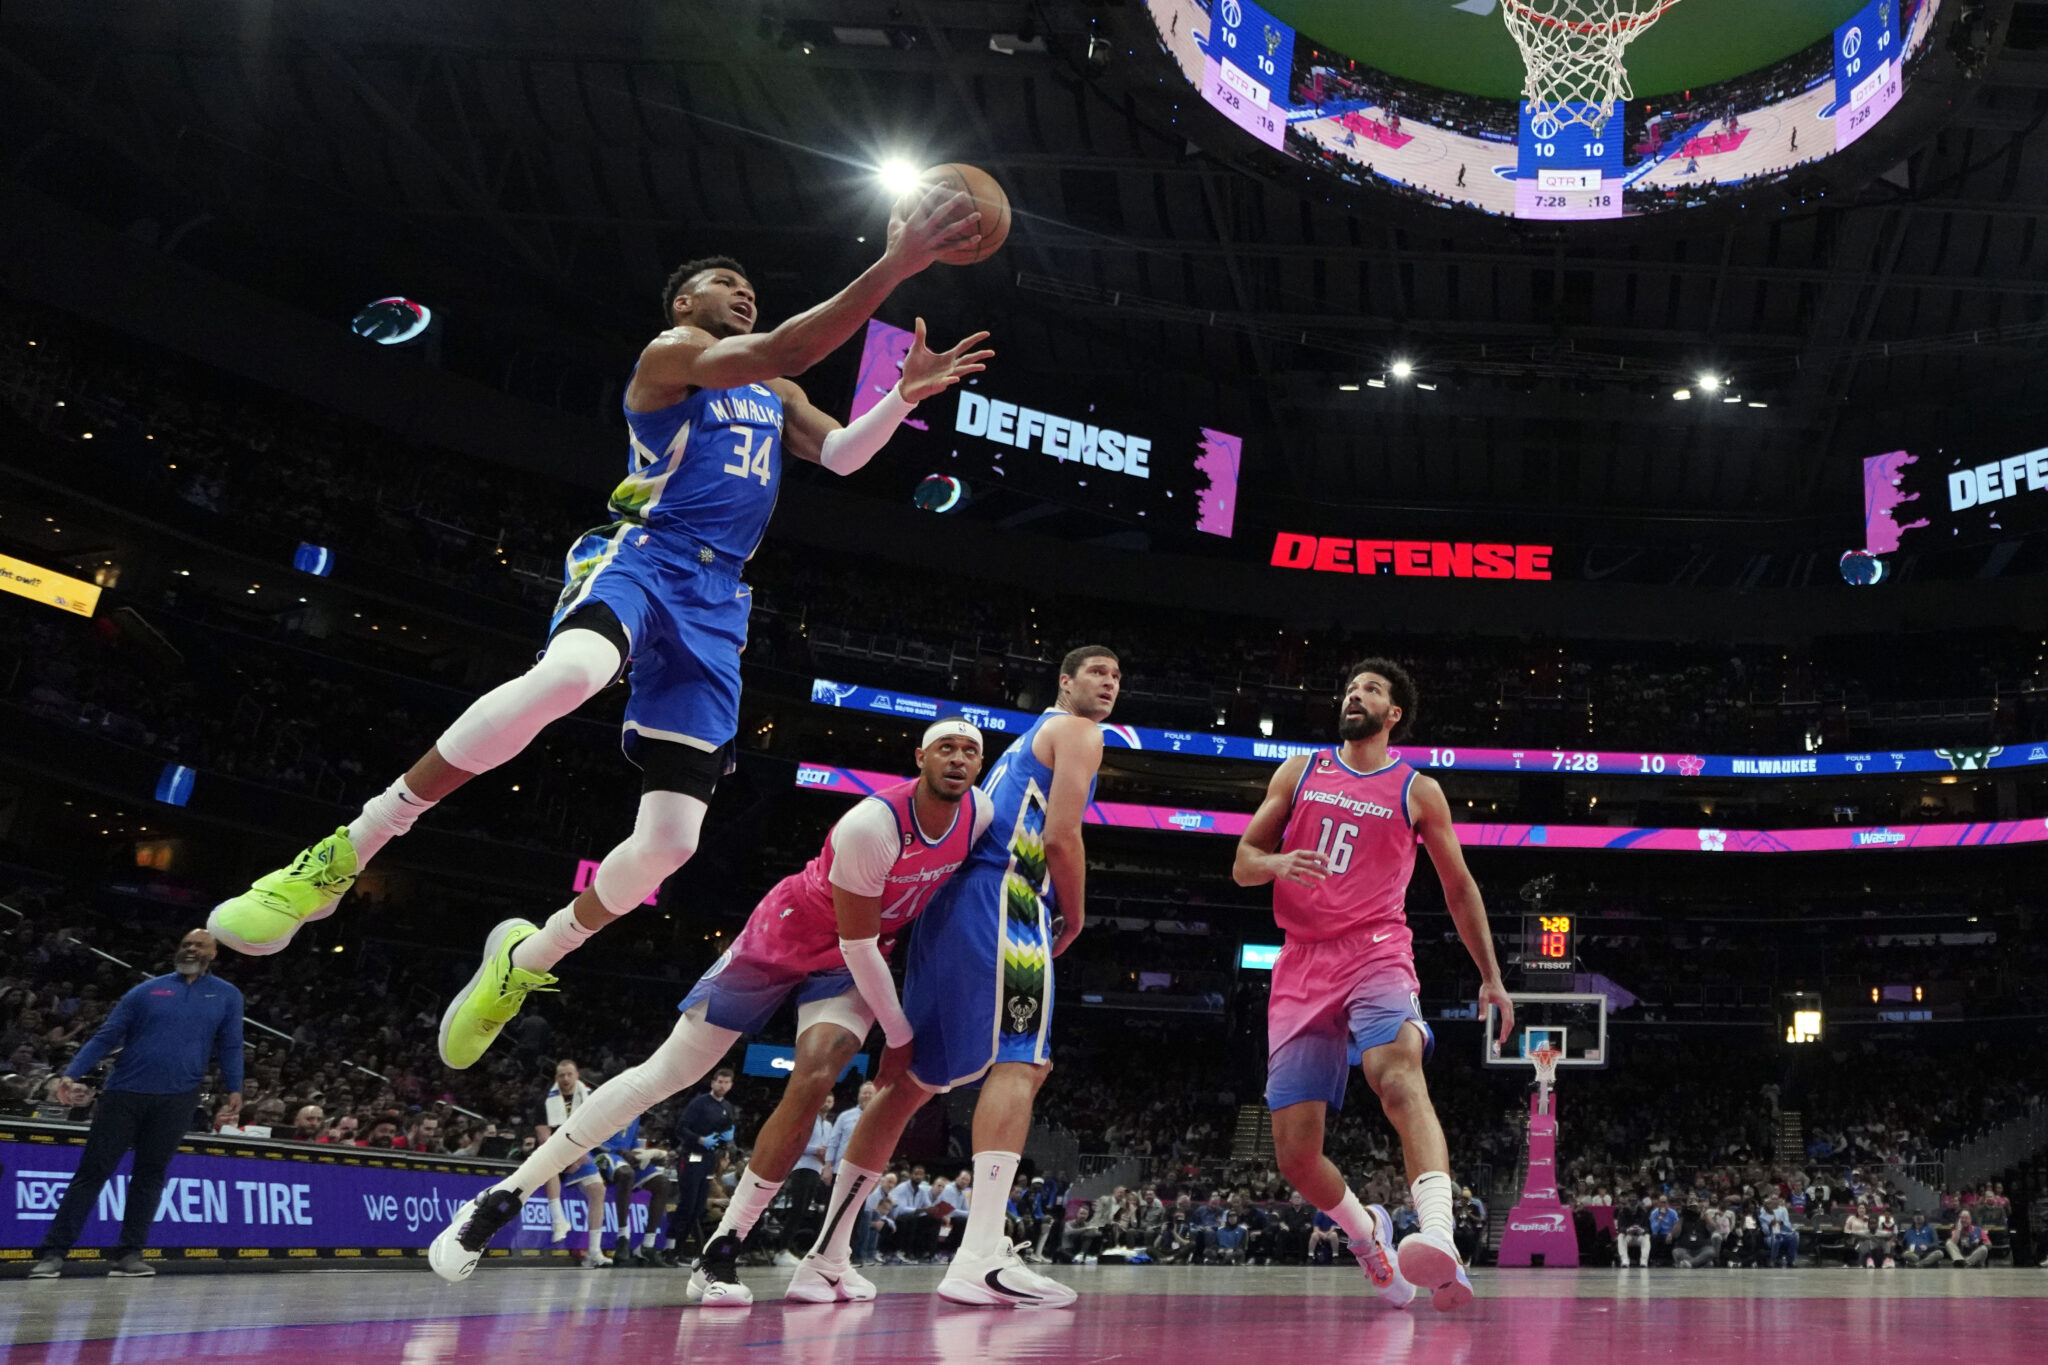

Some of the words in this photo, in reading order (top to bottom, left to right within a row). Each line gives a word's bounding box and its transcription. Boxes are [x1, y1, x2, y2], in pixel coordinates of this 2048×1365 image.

[1222, 27, 1237, 48] 10
[1878, 30, 1890, 51] 10
[1258, 55, 1274, 75] 10
[1846, 58, 1861, 77] 10
[1227, 69, 1249, 91] QTR
[1217, 83, 1240, 109] 7:28
[1856, 80, 1875, 101] QTR
[1257, 116, 1274, 132] :18
[1850, 106, 1870, 130] 7:28
[1534, 143, 1555, 157] 10
[1583, 143, 1604, 157] 10
[1546, 177, 1575, 186] QTR
[1535, 196, 1566, 207] 7:28
[1588, 196, 1611, 207] :18
[956, 390, 1151, 478] DEFENSE
[724, 424, 773, 486] 34
[1270, 531, 1553, 581] DEFENSE
[1164, 732, 1191, 741] FOULS
[1173, 741, 1181, 751] 2
[1217, 745, 1224, 754] 7
[1429, 749, 1455, 767] 10
[1515, 759, 1521, 769] 1
[1552, 752, 1599, 771] 7:28
[1640, 755, 1665, 773] 10
[1732, 759, 1817, 774] MILWAUKEE
[1855, 763, 1862, 772] 0
[1895, 761, 1902, 770] 7
[1303, 790, 1394, 820] washington
[904, 833, 912, 845] 6
[1314, 817, 1359, 874] 16
[1539, 916, 1570, 933] 7:28
[1542, 932, 1566, 957] 18
[99, 1174, 228, 1223] NXEN
[235, 1181, 312, 1225] TIRE
[363, 1194, 398, 1221] we
[404, 1187, 443, 1232] got
